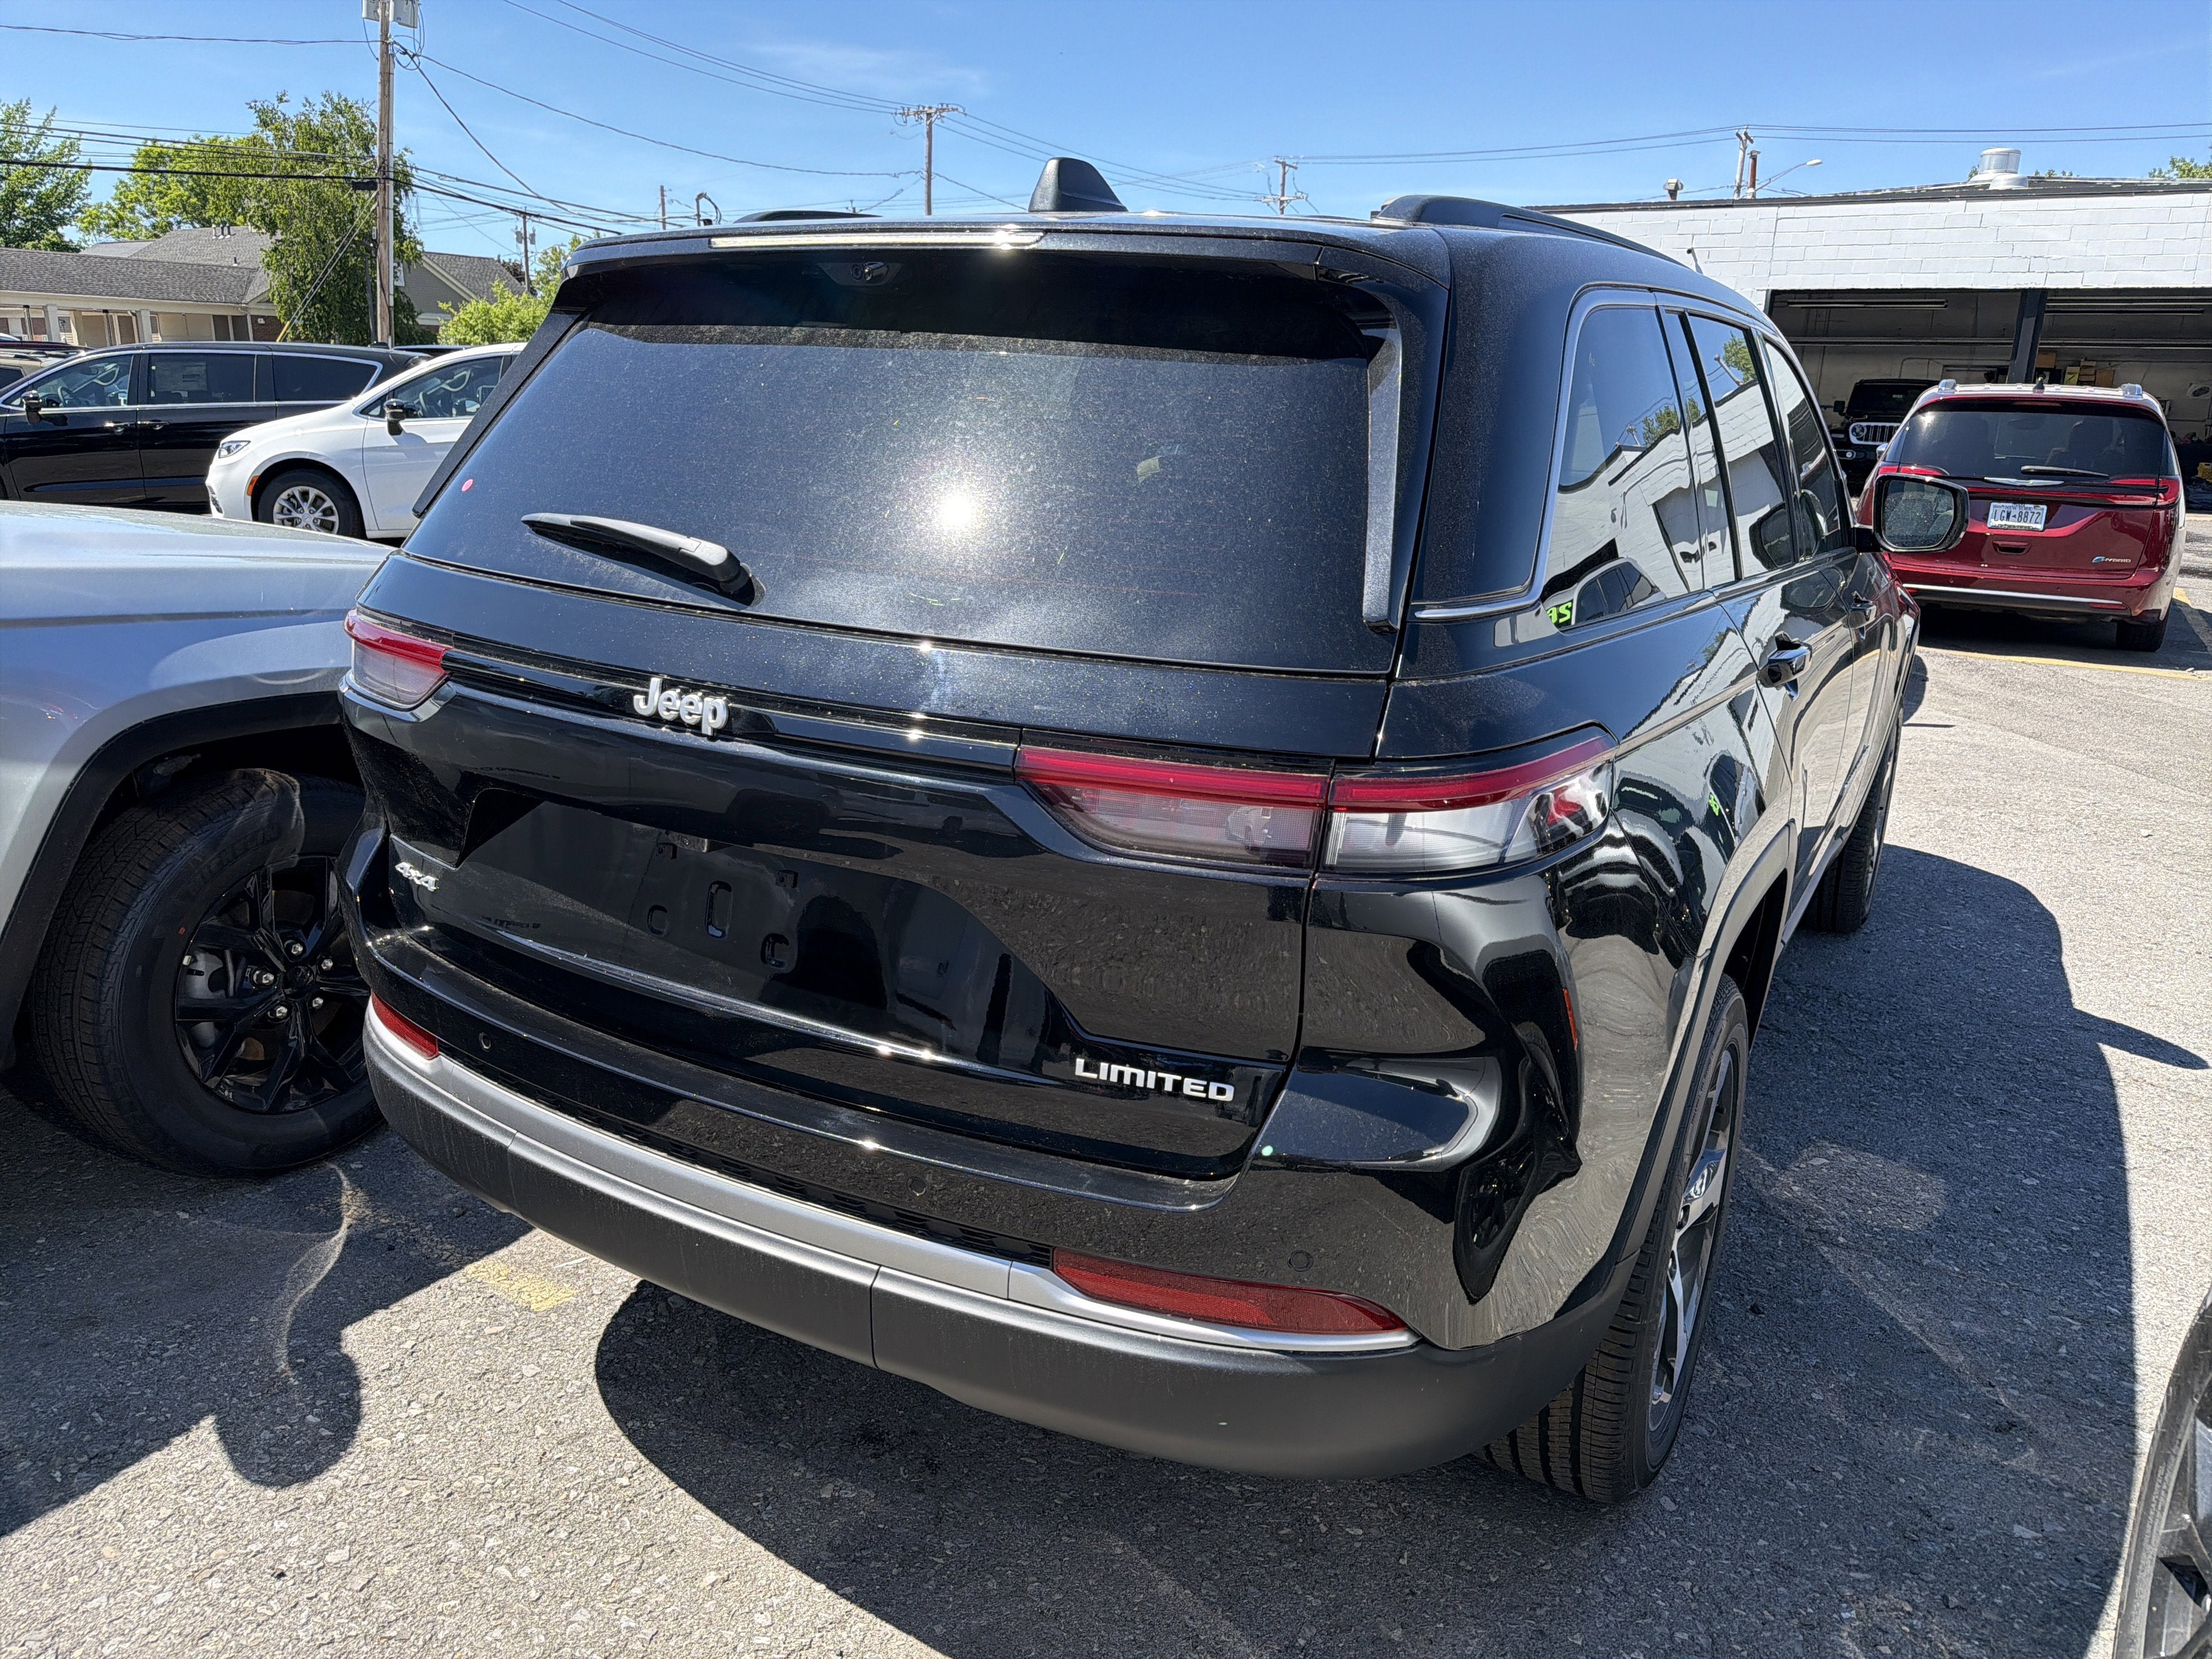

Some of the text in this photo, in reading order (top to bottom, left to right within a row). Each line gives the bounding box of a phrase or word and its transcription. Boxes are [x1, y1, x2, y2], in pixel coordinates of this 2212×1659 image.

[2017, 511, 2041, 524] 8872
[633, 677, 729, 736] Jeep
[1075, 1058, 1235, 1102] LIMITED
